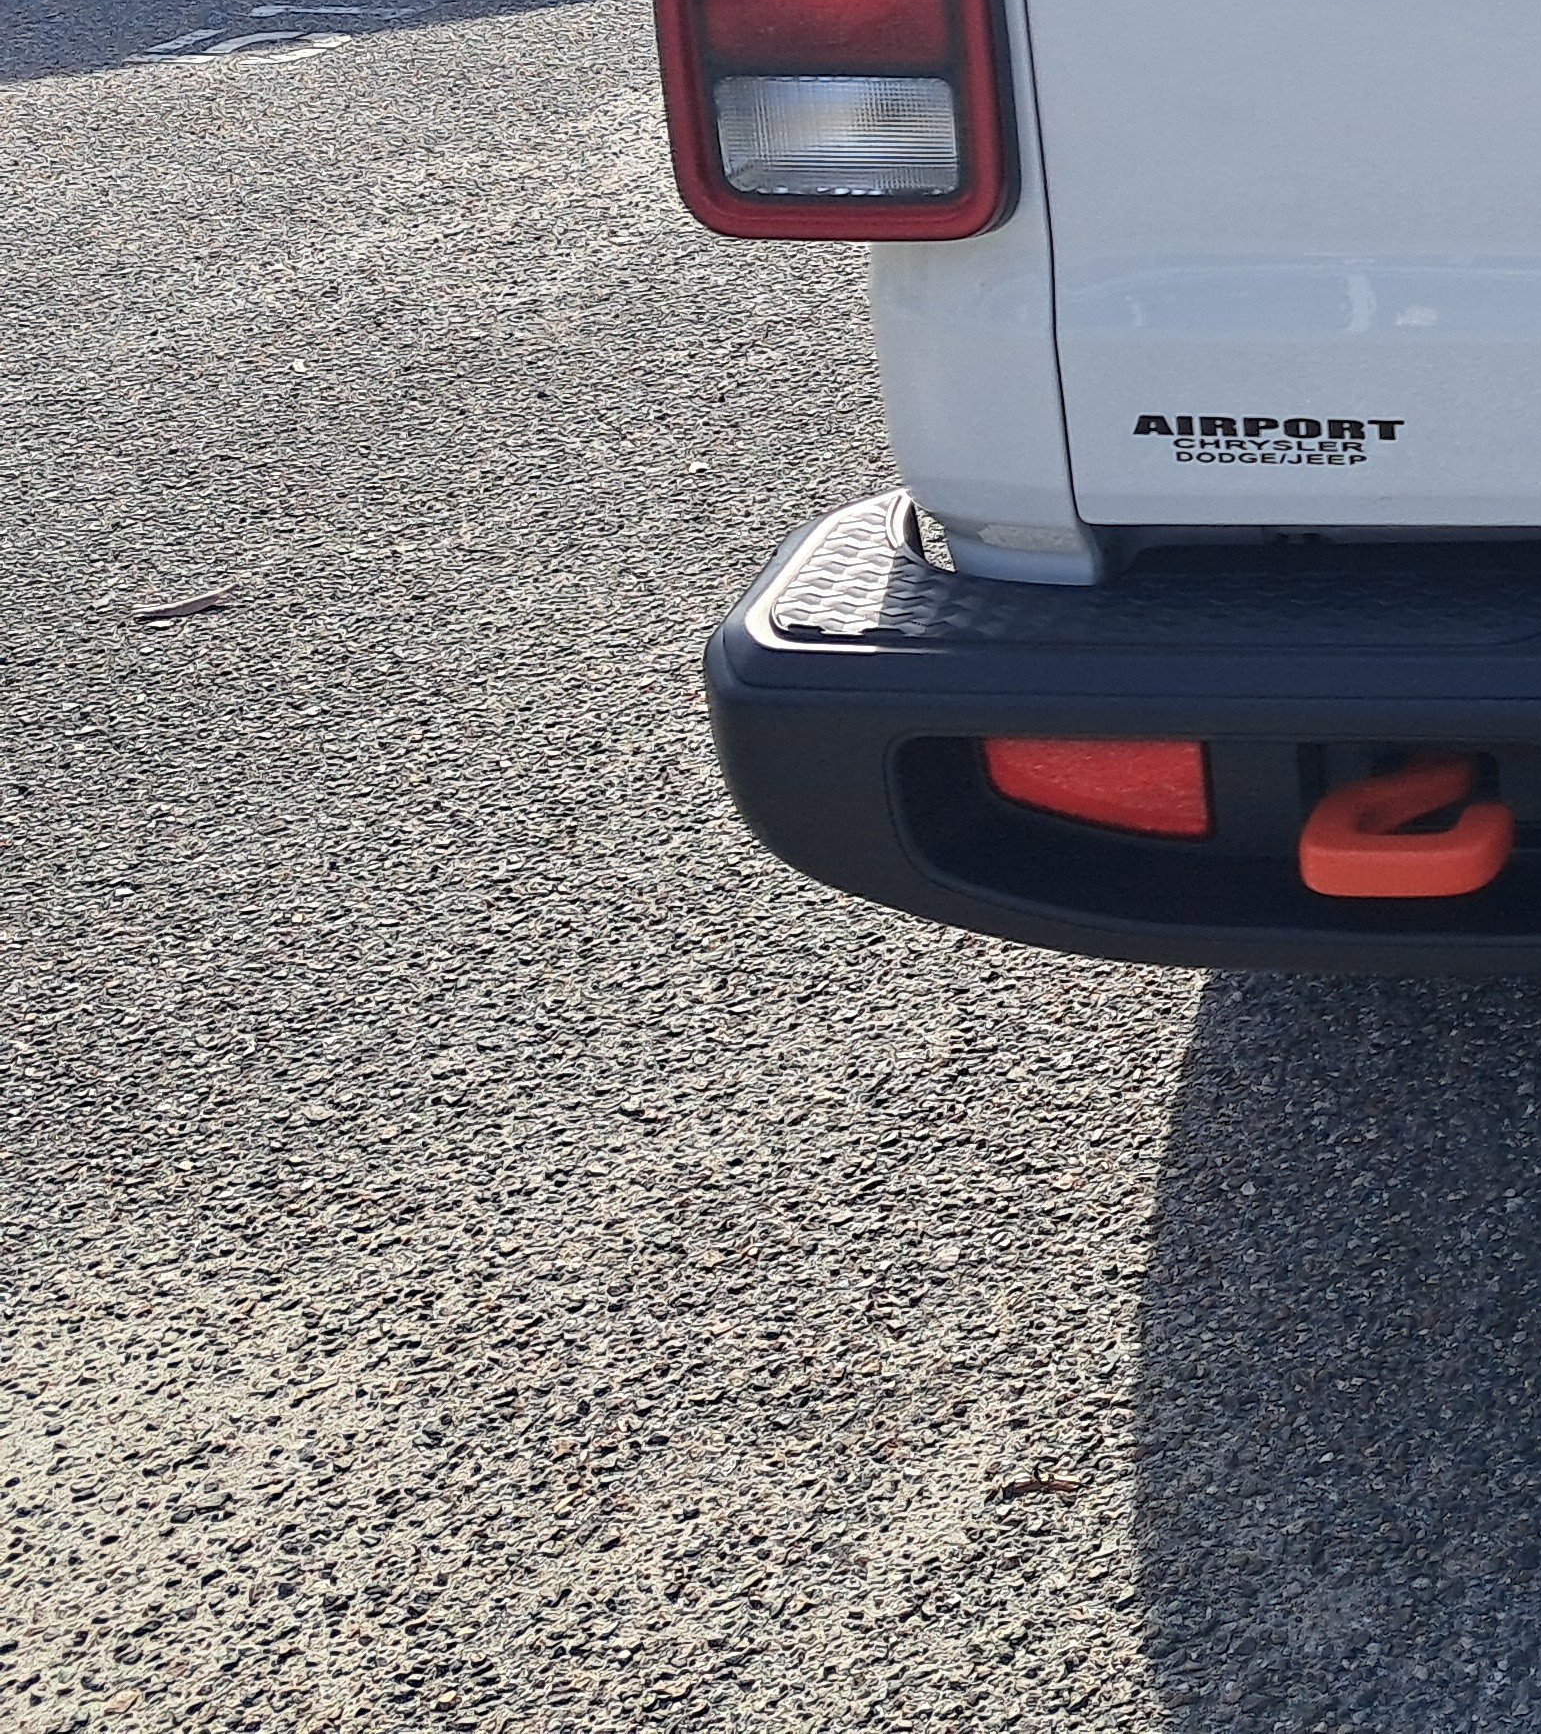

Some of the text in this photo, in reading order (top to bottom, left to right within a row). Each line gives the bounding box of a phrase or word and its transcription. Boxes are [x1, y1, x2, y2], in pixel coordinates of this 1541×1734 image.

[1132, 415, 1404, 441] AIRPORT
[1173, 438, 1364, 452] CHRYSLER
[1176, 452, 1367, 465] DODGE/JEEP
